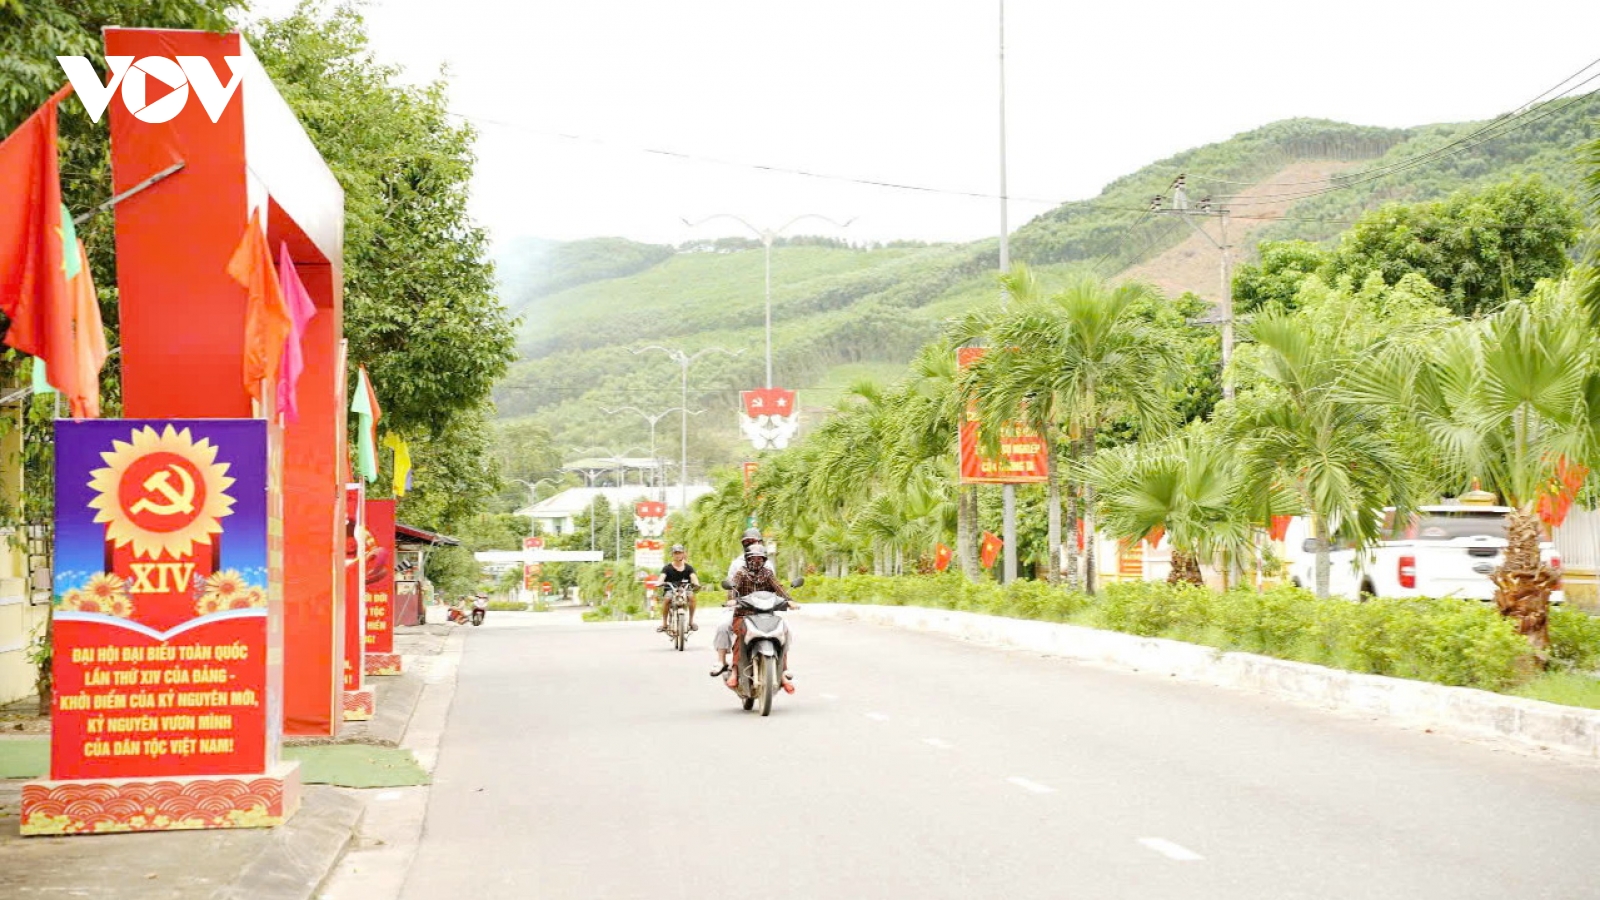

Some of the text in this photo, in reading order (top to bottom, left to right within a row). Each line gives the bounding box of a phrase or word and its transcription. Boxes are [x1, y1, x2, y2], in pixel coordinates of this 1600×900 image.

[129, 563, 196, 592] XIV
[72, 640, 248, 665] ĐẠI HỘI ĐẠI BIỂU TOÀN QUỐC
[113, 668, 139, 685] THỨ
[140, 670, 161, 685] XIV
[163, 665, 190, 684] CỦA
[192, 664, 227, 684] ĐẢNG
[60, 690, 91, 710] KHỞI
[94, 689, 126, 709] ĐIỂM
[129, 689, 155, 709] CỦA
[158, 688, 175, 707] KỶ
[177, 689, 228, 707] NGUYÊN
[87, 712, 232, 733] KỶ NGUYÊN VƯƠN MÌNH
[84, 737, 234, 758] CỦA DÂN TỘC VIỆT NAM!
